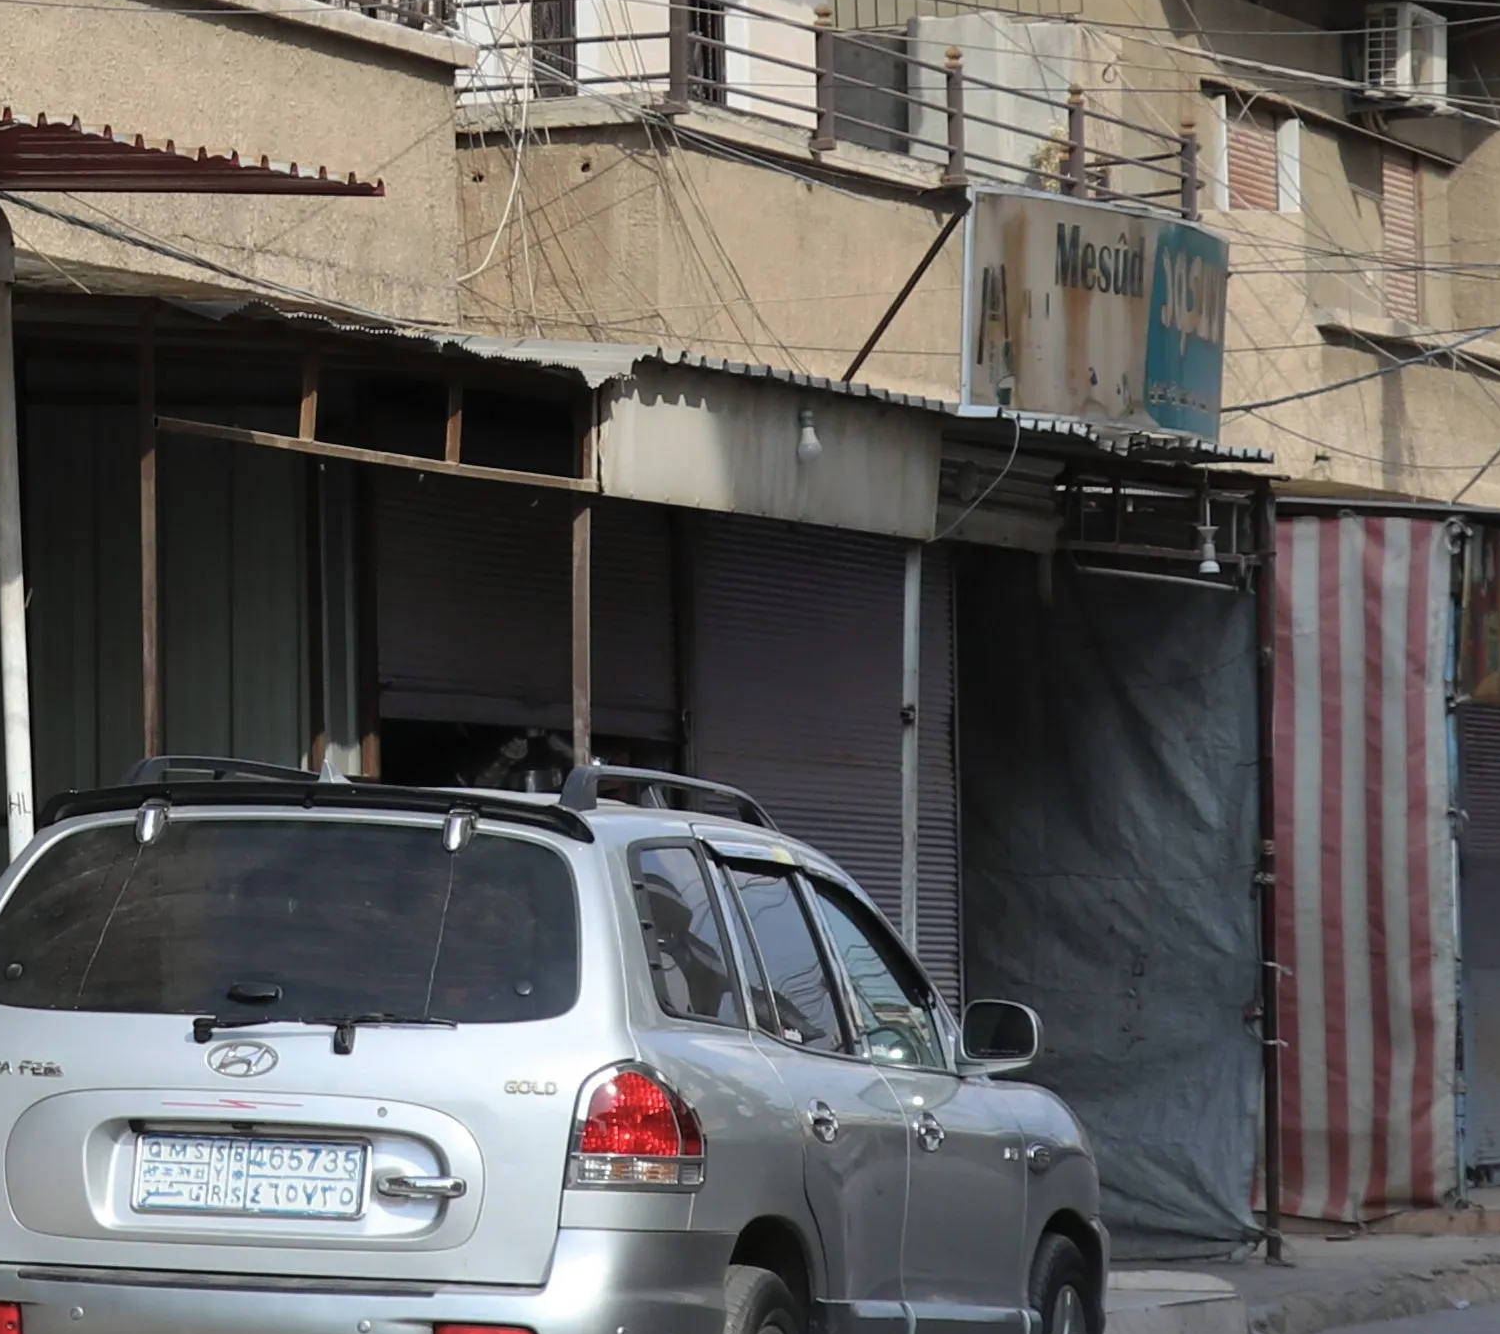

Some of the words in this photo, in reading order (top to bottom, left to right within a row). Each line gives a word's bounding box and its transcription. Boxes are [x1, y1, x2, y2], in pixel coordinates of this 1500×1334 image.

[1055, 222, 1145, 299] Mesûd
[504, 1080, 558, 1096] GOLD
[250, 1146, 359, 1173] 465735
